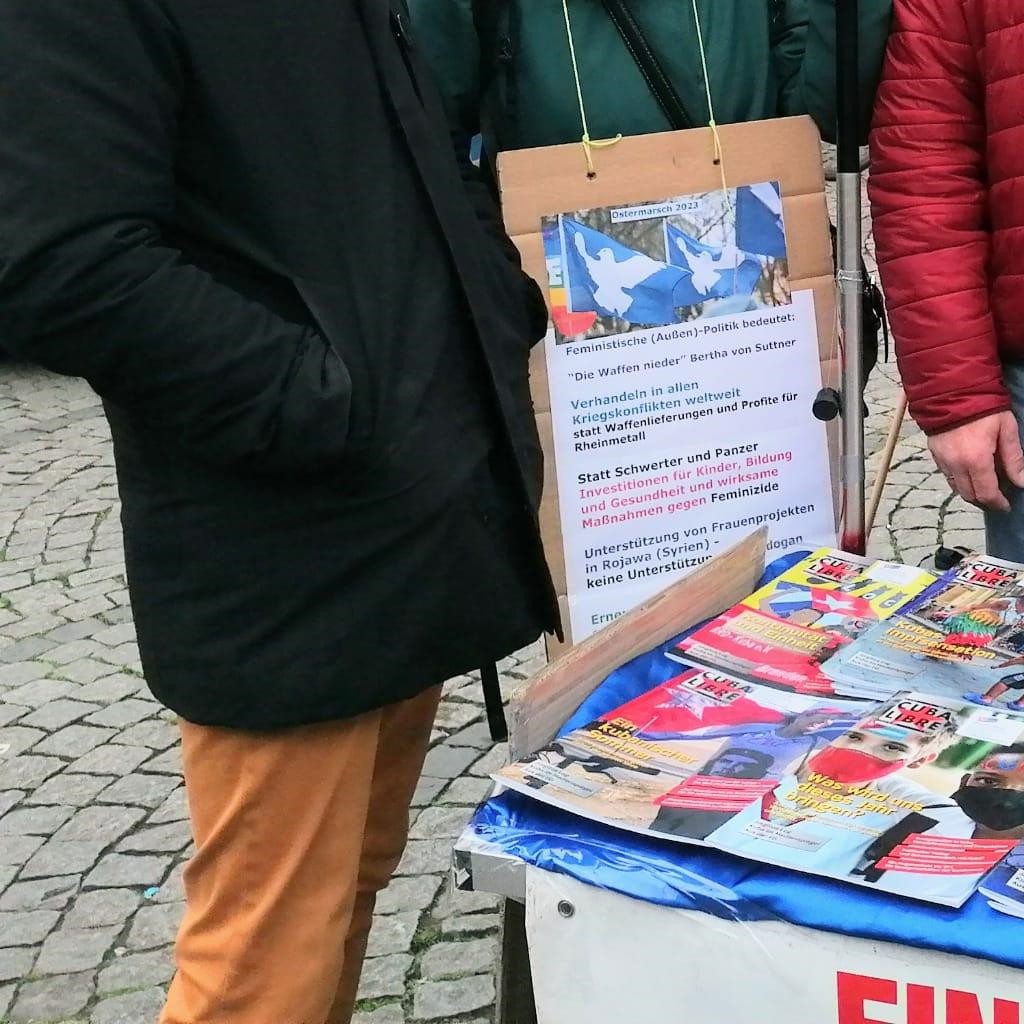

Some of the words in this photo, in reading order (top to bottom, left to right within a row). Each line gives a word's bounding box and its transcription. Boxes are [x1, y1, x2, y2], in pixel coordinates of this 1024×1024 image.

[611, 204, 673, 220] Ostermarsch
[676, 201, 699, 213] 2023
[566, 335, 648, 356] Feministische
[650, 321, 740, 346] (Außen)-Politik
[742, 312, 796, 329] bedeutet:
[598, 361, 641, 377] Waffen
[690, 348, 729, 363] Bertha
[732, 345, 752, 356] von
[755, 338, 797, 354] Suttner
[570, 387, 648, 411] Verhandeln
[651, 384, 664, 397] in
[667, 380, 700, 394] allen
[572, 398, 682, 426] Kriegskonflikten
[685, 387, 741, 406] weltweit
[573, 426, 602, 439] statt
[605, 406, 714, 433] Waffenlieferungen
[716, 400, 739, 414] und
[741, 393, 780, 410] Profite
[782, 391, 799, 404] für
[574, 432, 647, 452] Rheinmetall
[577, 468, 611, 484] Statt
[615, 455, 683, 478] Schwerter
[687, 450, 711, 464] und
[715, 442, 759, 460] Panzer
[579, 472, 670, 499] Investitionen
[672, 468, 692, 482] für
[695, 459, 743, 479] Kinder,
[745, 449, 793, 470] Bildung
[580, 499, 607, 515] und
[610, 484, 686, 509] Gesundheit
[689, 478, 714, 494] und
[717, 467, 779, 488] wirksame
[582, 505, 664, 529] Maßnahmen
[667, 495, 707, 516] gegen
[710, 481, 780, 503] Feminizide
[584, 532, 680, 560] Unterstützung
[683, 523, 708, 538] von
[711, 503, 815, 533] Frauenprojekten
[585, 561, 599, 575] in
[602, 550, 652, 573] Rojawa
[656, 538, 710, 562] (Syrien)
[586, 574, 624, 589] keine
[766, 534, 804, 553] dogan
[820, 557, 865, 574] CUBA
[971, 560, 1018, 580] CUBA
[961, 569, 1012, 587] LIBRE
[591, 610, 625, 625] Erne
[763, 629, 818, 650] Einheit
[885, 628, 997, 660] Impfsensation
[687, 678, 740, 701] LIBRE
[702, 671, 752, 693] CUBA
[612, 716, 639, 732] Ein
[884, 710, 942, 731] LIBRE
[897, 700, 951, 722] CUBA
[588, 730, 653, 761] Sommer
[784, 788, 867, 818] bringen?
[796, 782, 855, 805] dieses
[860, 801, 898, 816] Jahr
[807, 772, 844, 791] Was
[847, 784, 890, 802] wird
[891, 797, 925, 812] uns
